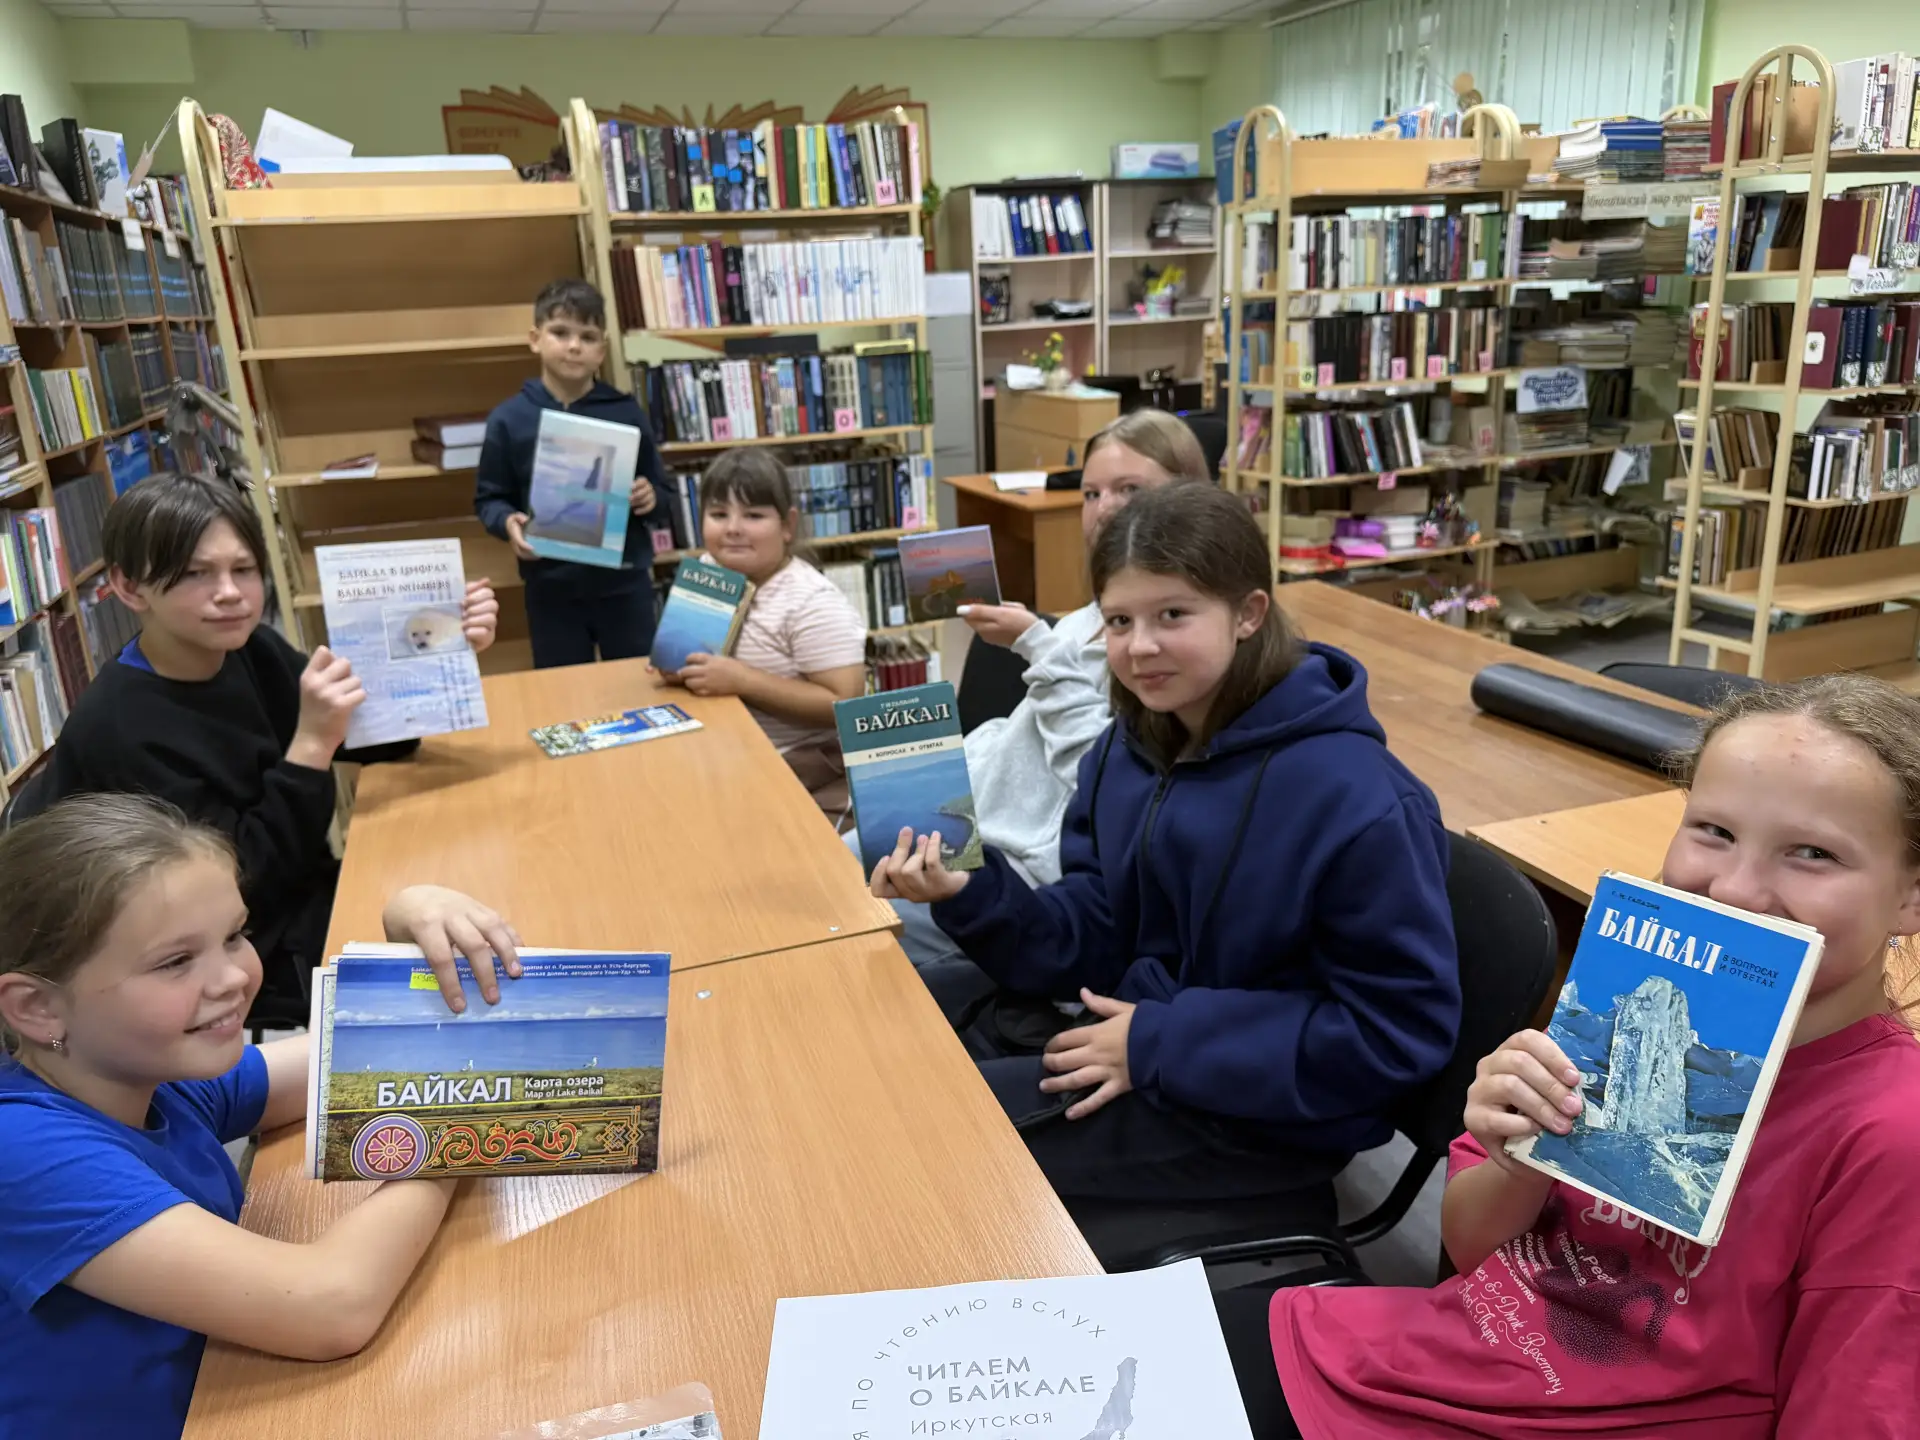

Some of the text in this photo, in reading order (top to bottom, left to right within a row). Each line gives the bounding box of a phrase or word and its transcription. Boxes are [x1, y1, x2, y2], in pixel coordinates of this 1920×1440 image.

[854, 703, 951, 734] БАЙКАЛ
[1597, 907, 1724, 975] БАЙКАЛ
[1729, 967, 1775, 988] ОТВЕТАХ
[1730, 957, 1779, 979] ВОПРОСАХ
[377, 1074, 604, 1107] БАЙКАЛ Карта озера
[524, 1087, 603, 1099] Map of Lake Baikal
[1495, 1247, 1537, 1305] SELF-CONTROL
[907, 1356, 1031, 1382] ЧИТАЕМ
[909, 1375, 1096, 1407] О БАЙКАЛЕ
[911, 1411, 1053, 1436] Иркутская
